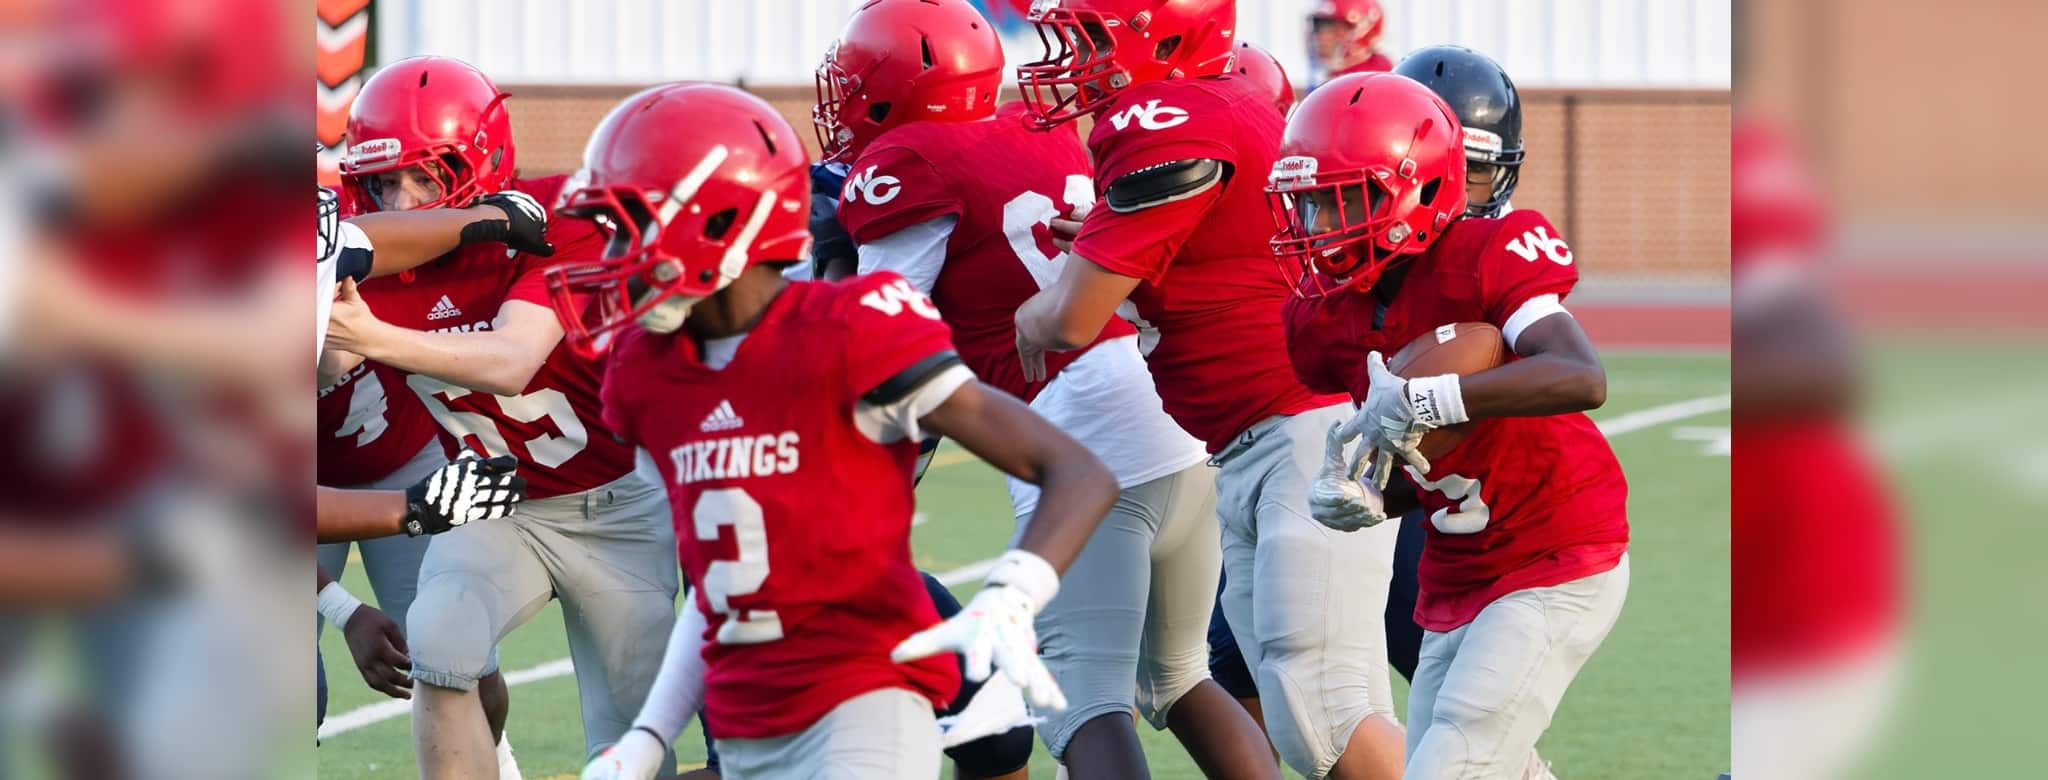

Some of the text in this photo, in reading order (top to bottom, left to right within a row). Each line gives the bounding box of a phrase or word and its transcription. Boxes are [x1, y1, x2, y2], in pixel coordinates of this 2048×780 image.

[1505, 225, 1574, 267] WC
[427, 308, 462, 320] adidas
[334, 369, 388, 448] 4
[670, 430, 800, 484] VIKINGS
[692, 487, 784, 644] 2
